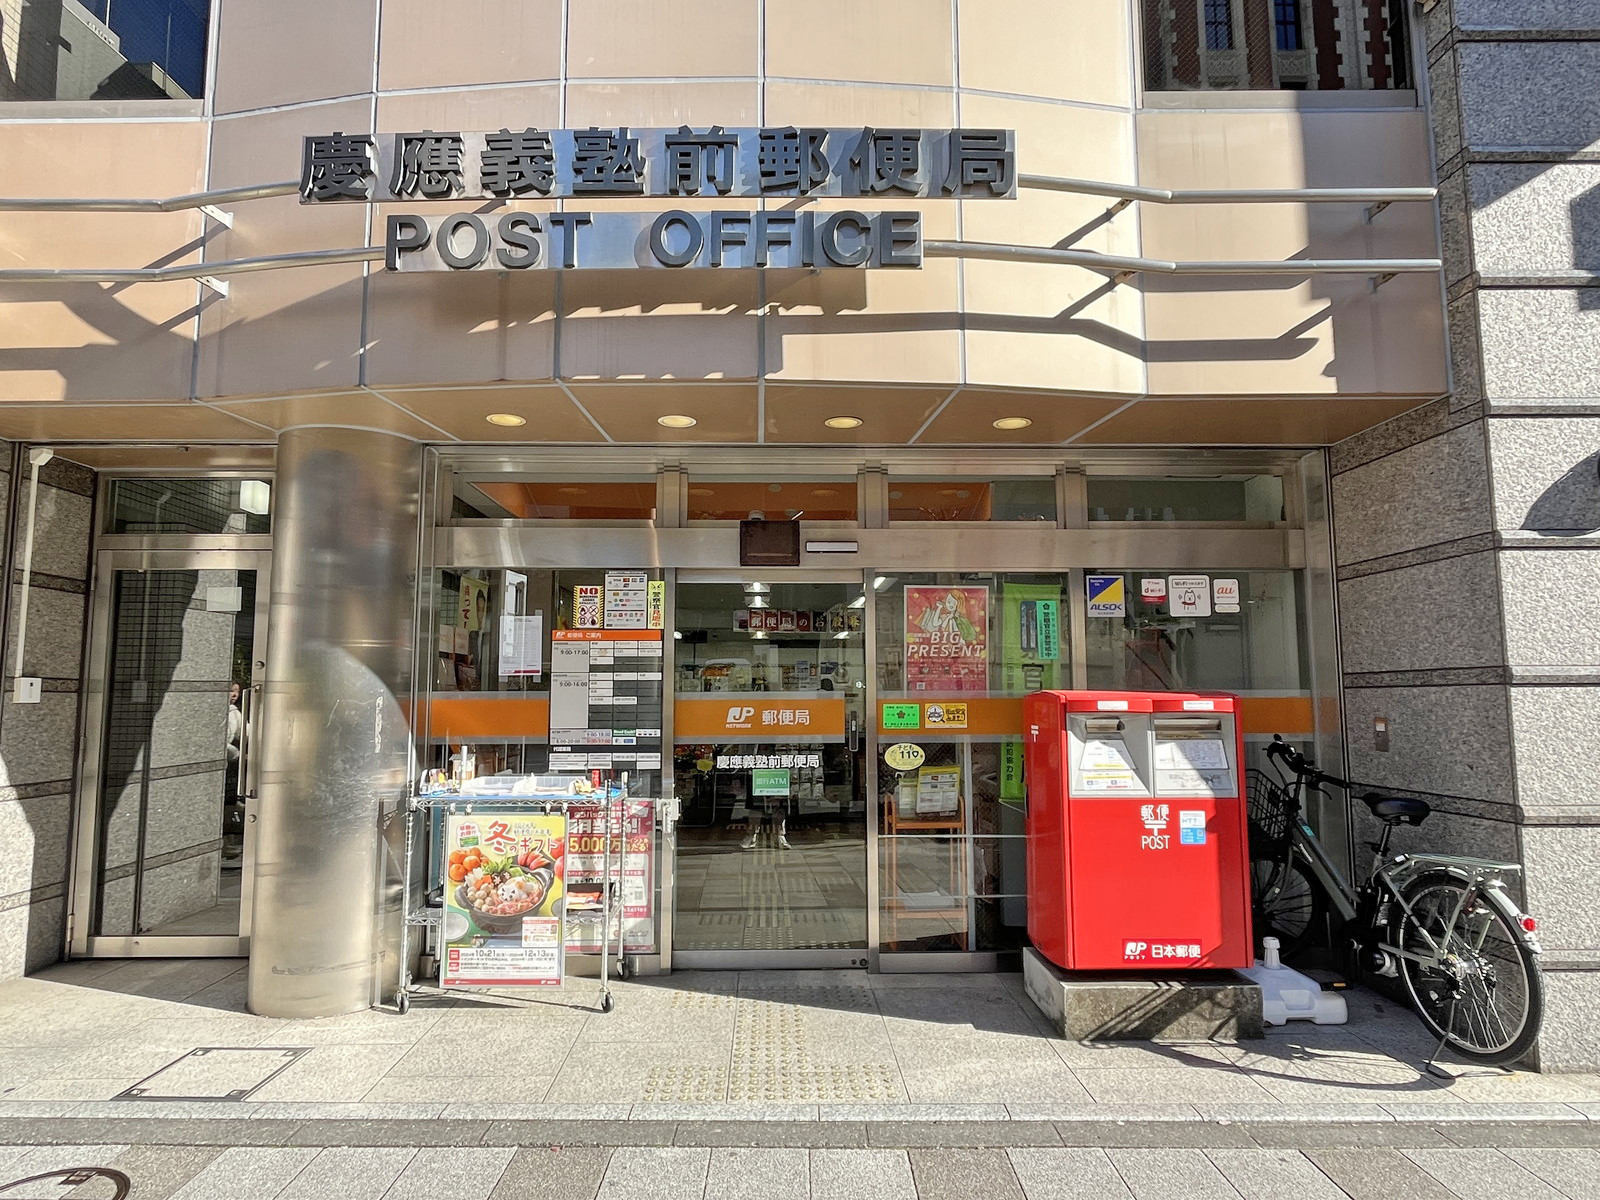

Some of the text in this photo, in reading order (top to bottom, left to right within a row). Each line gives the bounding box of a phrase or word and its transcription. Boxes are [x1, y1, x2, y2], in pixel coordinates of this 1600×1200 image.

[300, 127, 1015, 199] 慶應義塾前郵便局
[387, 210, 921, 272] POST OFFICE
[579, 587, 599, 595] NO
[1217, 586, 1235, 595] au
[1090, 603, 1123, 611] ALSOK
[930, 631, 960, 644] BIG
[907, 644, 984, 657] PRESENT
[762, 709, 810, 726] 郵便局
[716, 754, 820, 769] 慶應義塾前郵便局
[1140, 804, 1170, 821] 郵便
[484, 820, 558, 853] 冬のギフト
[1141, 835, 1171, 850] POST
[1151, 944, 1202, 959] 日本郵便
